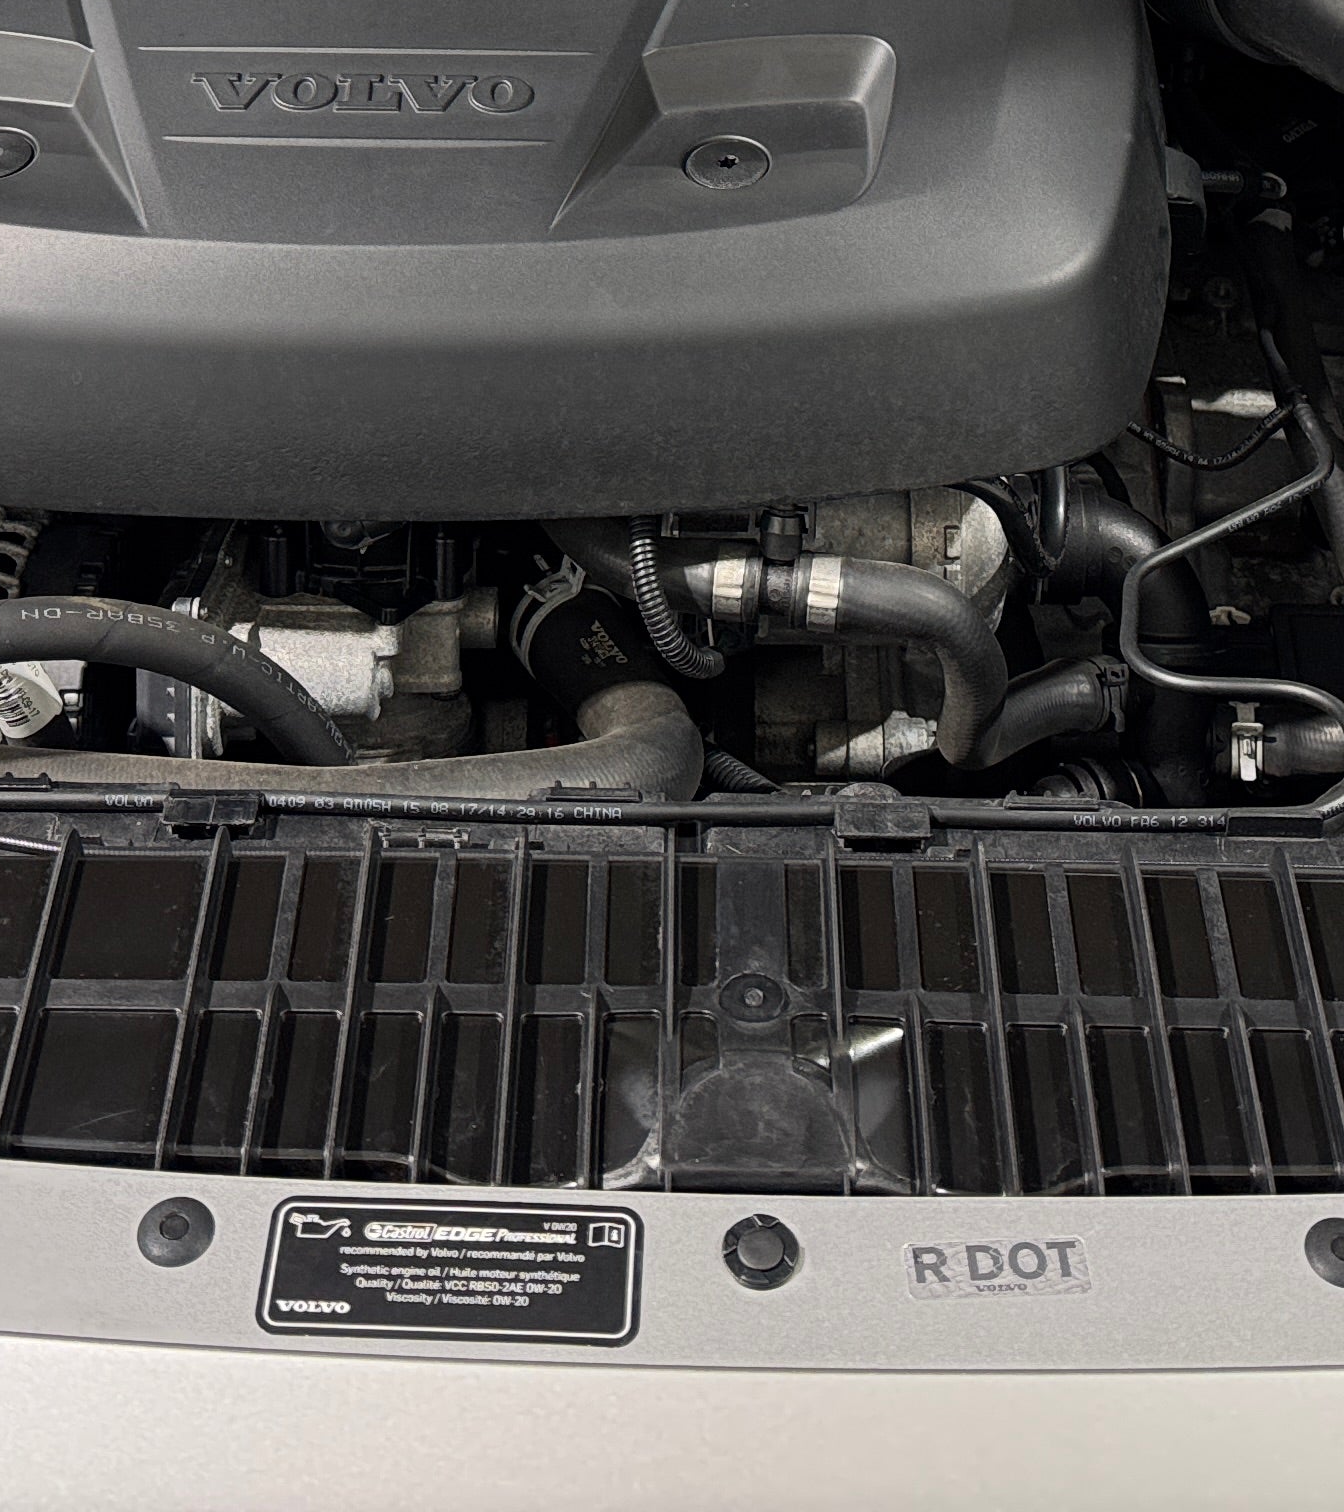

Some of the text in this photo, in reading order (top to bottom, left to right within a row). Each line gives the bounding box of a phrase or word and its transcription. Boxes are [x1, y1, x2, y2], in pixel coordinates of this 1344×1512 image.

[191, 72, 536, 114] VOLVO
[573, 807, 622, 820] CHINA
[1073, 816, 1122, 827] VOLVO
[1170, 816, 1188, 826] 12
[381, 1224, 431, 1240] Castrol
[433, 1227, 497, 1242] EDGE
[339, 1246, 585, 1263] recommended by Volvo / recommandé par Volvo
[912, 1241, 1077, 1284] R DOT
[339, 1263, 390, 1276] Synthetic
[391, 1266, 426, 1278] engine
[428, 1267, 441, 1277] oil
[449, 1267, 477, 1278] Huile
[479, 1270, 518, 1280] moteur
[519, 1270, 580, 1283] synthétique
[356, 1277, 394, 1290] Quality
[444, 1280, 468, 1291] VCC
[526, 1283, 563, 1294] 0W-20
[976, 1283, 1028, 1292] VOLVO
[276, 1299, 351, 1314] VOLVO
[386, 1292, 433, 1305] Viscosity
[492, 1295, 529, 1307] 0W-20
